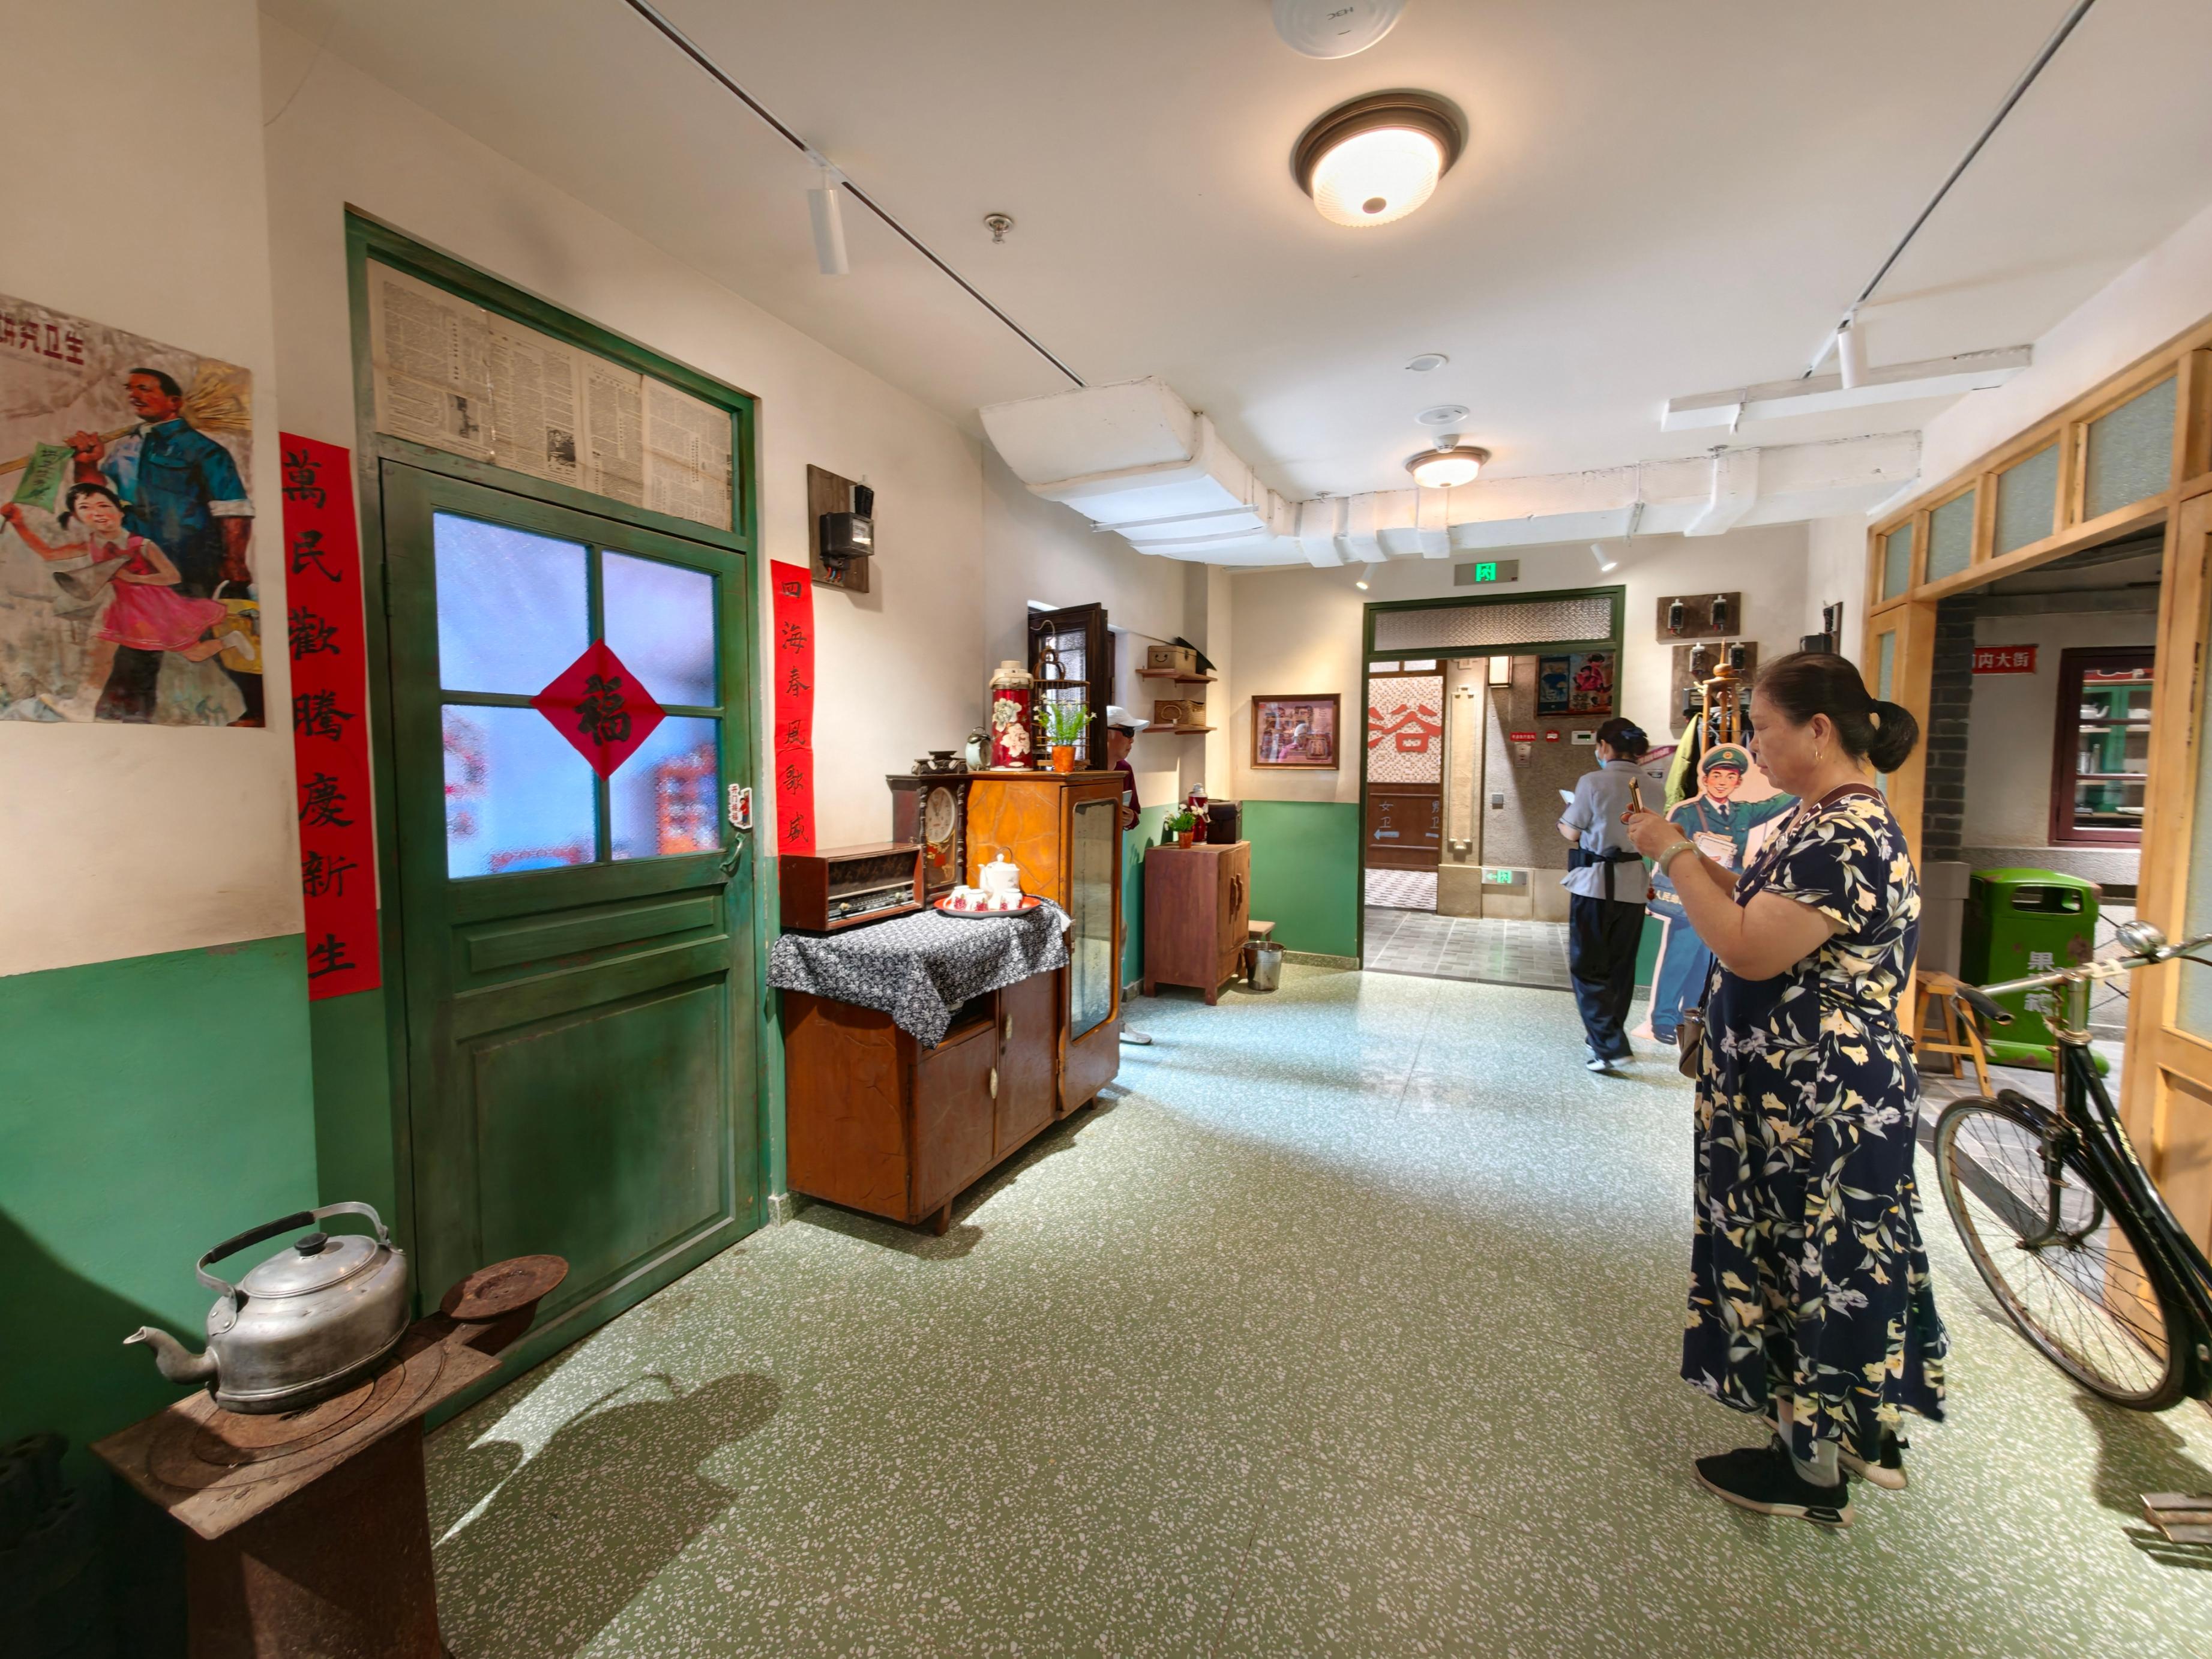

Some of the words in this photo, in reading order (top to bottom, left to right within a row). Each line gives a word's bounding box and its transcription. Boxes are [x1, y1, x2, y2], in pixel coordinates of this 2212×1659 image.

[1327, 7, 1354, 20] H3C
[1972, 652, 2029, 669] 内大街
[574, 674, 633, 746] 福
[1368, 703, 1441, 753] 浴
[1379, 801, 1393, 828] 女卫
[1430, 801, 1440, 828] 男卫
[2023, 951, 2056, 1016] 果箱
